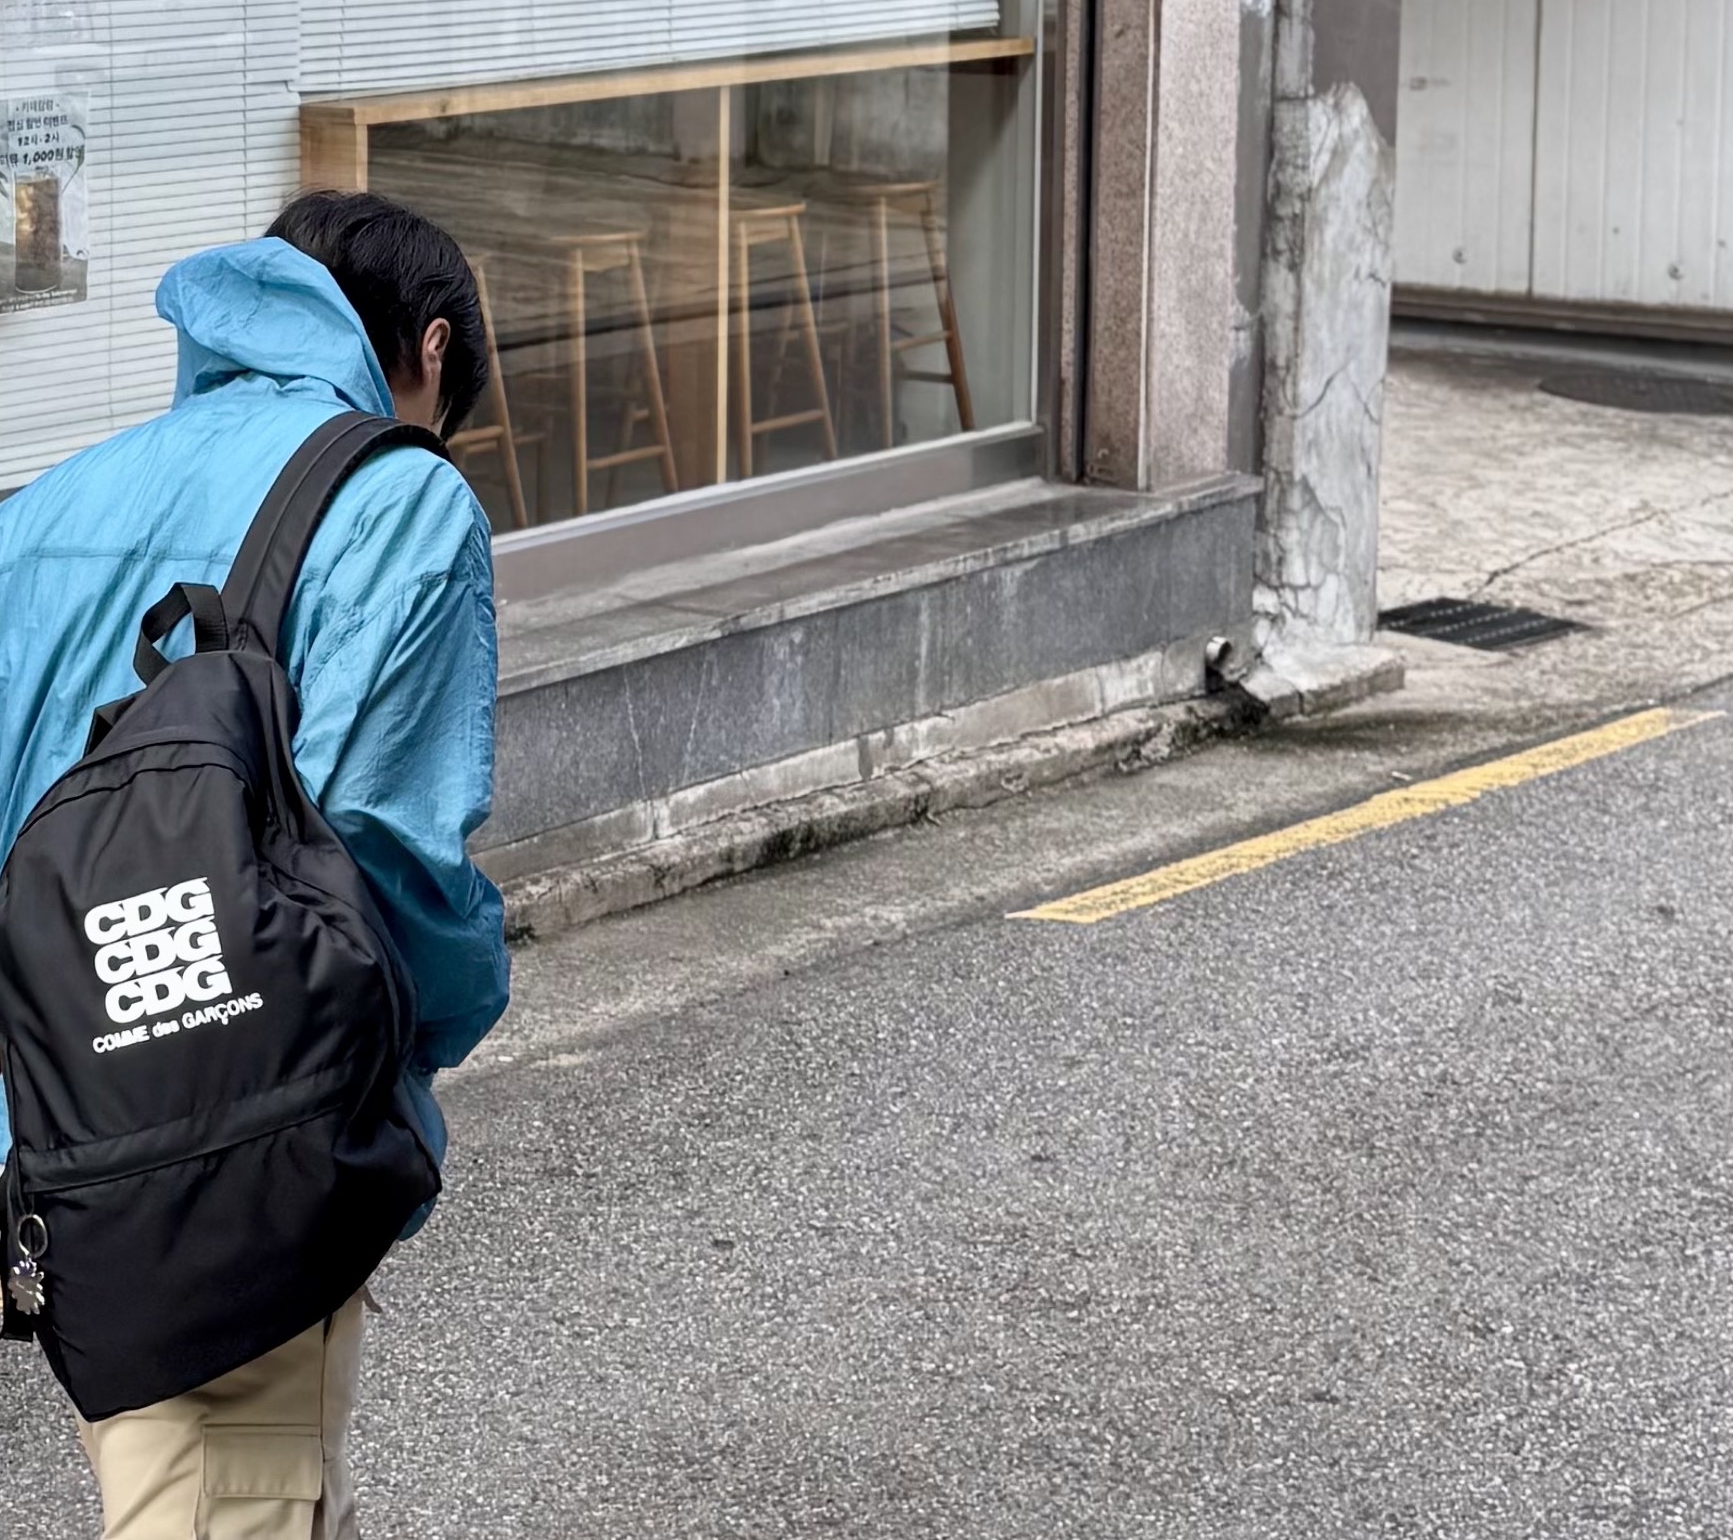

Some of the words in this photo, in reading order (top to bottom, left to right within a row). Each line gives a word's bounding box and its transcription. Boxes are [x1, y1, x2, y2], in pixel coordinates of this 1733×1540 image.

[84, 876, 215, 945] CDG
[94, 915, 223, 984] CDG
[92, 1025, 150, 1053] COMME
[152, 1019, 180, 1038] des
[182, 992, 264, 1026] GARÇONS
[105, 954, 233, 1023] CDG
